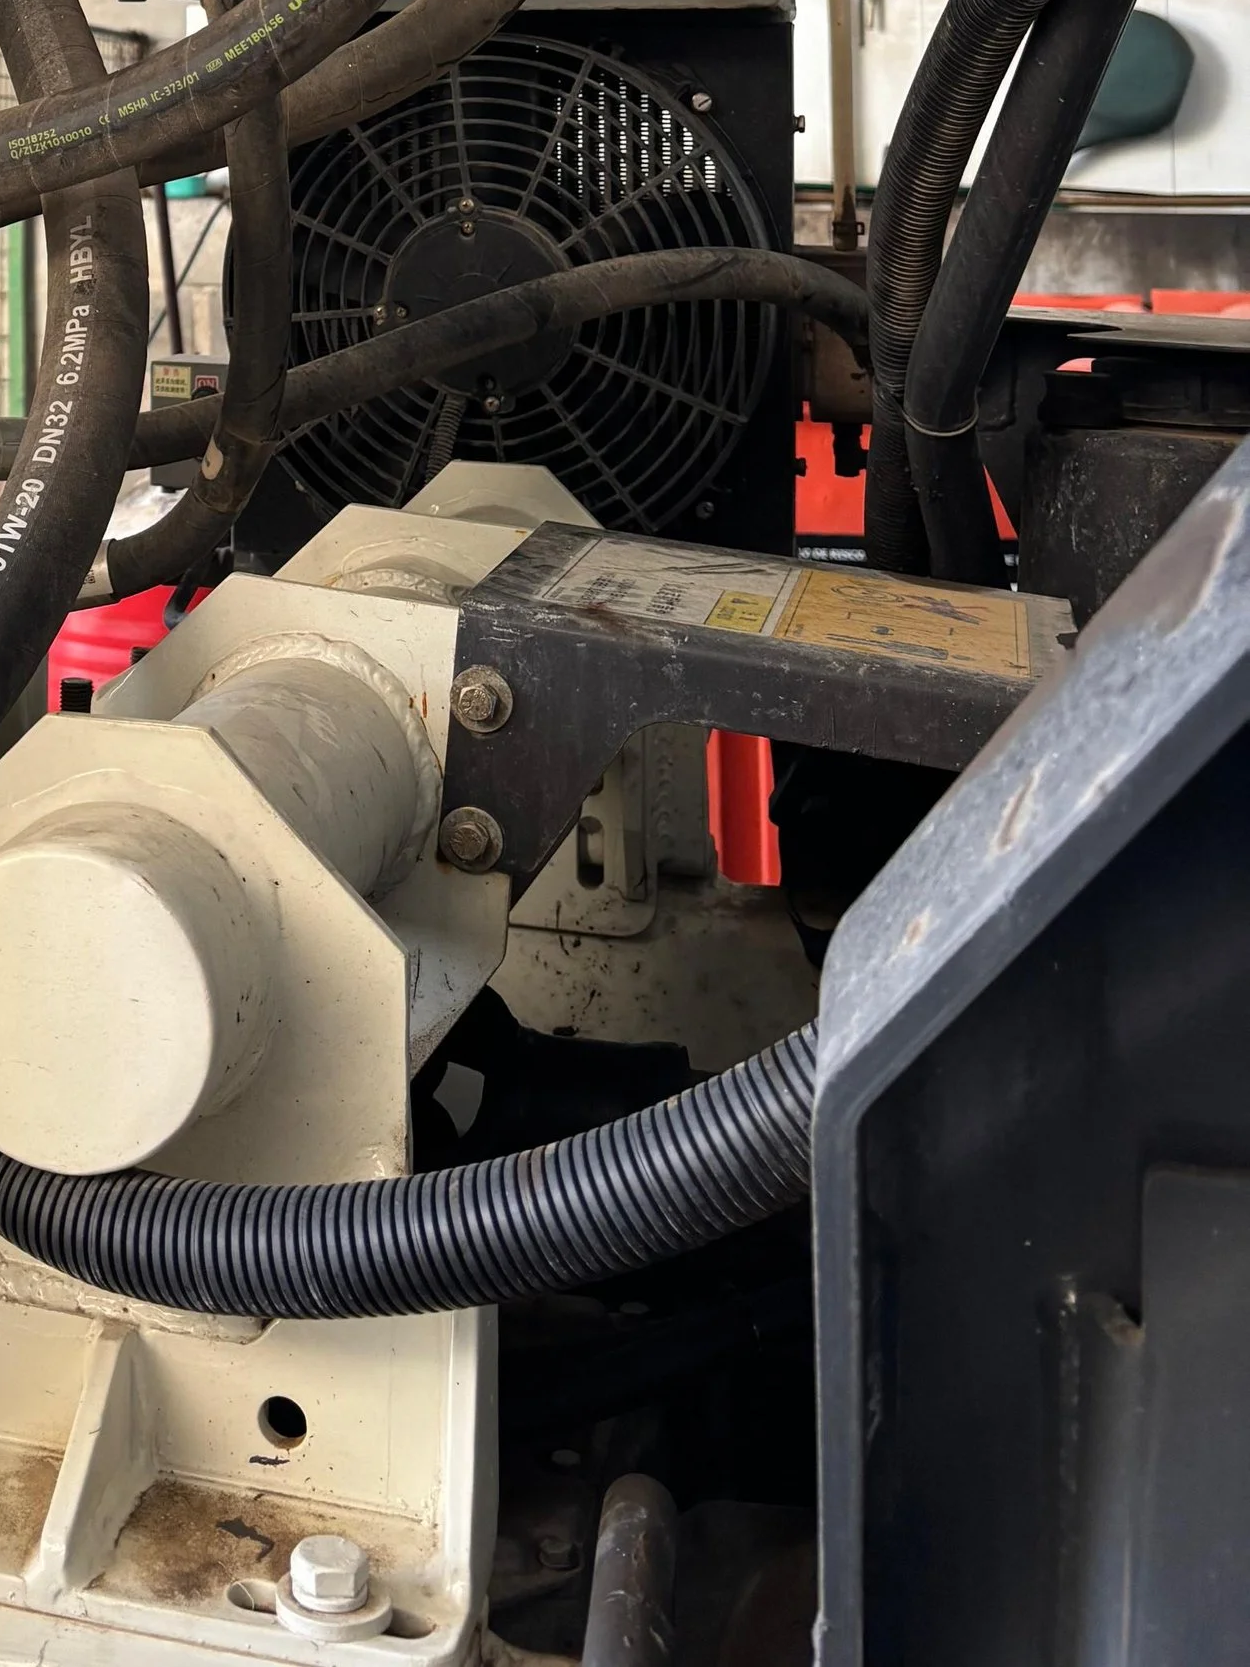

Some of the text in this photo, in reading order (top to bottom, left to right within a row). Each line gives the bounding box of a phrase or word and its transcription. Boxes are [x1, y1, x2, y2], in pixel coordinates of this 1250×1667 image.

[117, 97, 149, 119] MSHA
[149, 71, 201, 104] IC-373/01
[7, 127, 58, 150] ISO18752
[69, 214, 94, 285] HBYL
[55, 304, 91, 386] 6.2MPa
[31, 399, 74, 465] DN32
